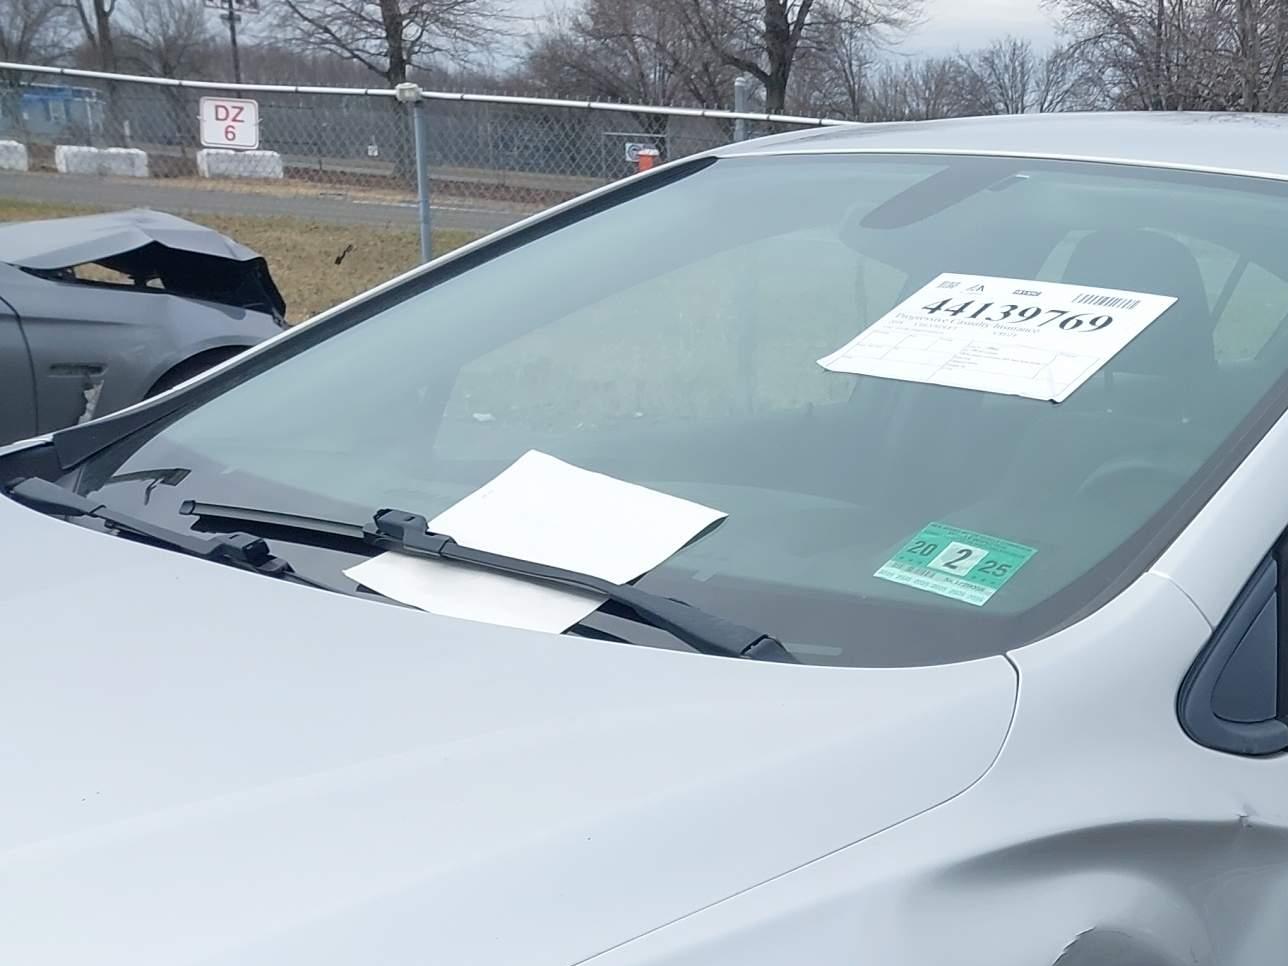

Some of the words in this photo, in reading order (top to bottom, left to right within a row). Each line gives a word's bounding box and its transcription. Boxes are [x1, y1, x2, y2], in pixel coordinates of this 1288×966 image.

[214, 104, 245, 123] DZ
[224, 125, 236, 142] 6
[921, 297, 1114, 334] 44139769
[907, 540, 938, 557] 20
[943, 548, 972, 570] 2
[978, 560, 1012, 577] 25
